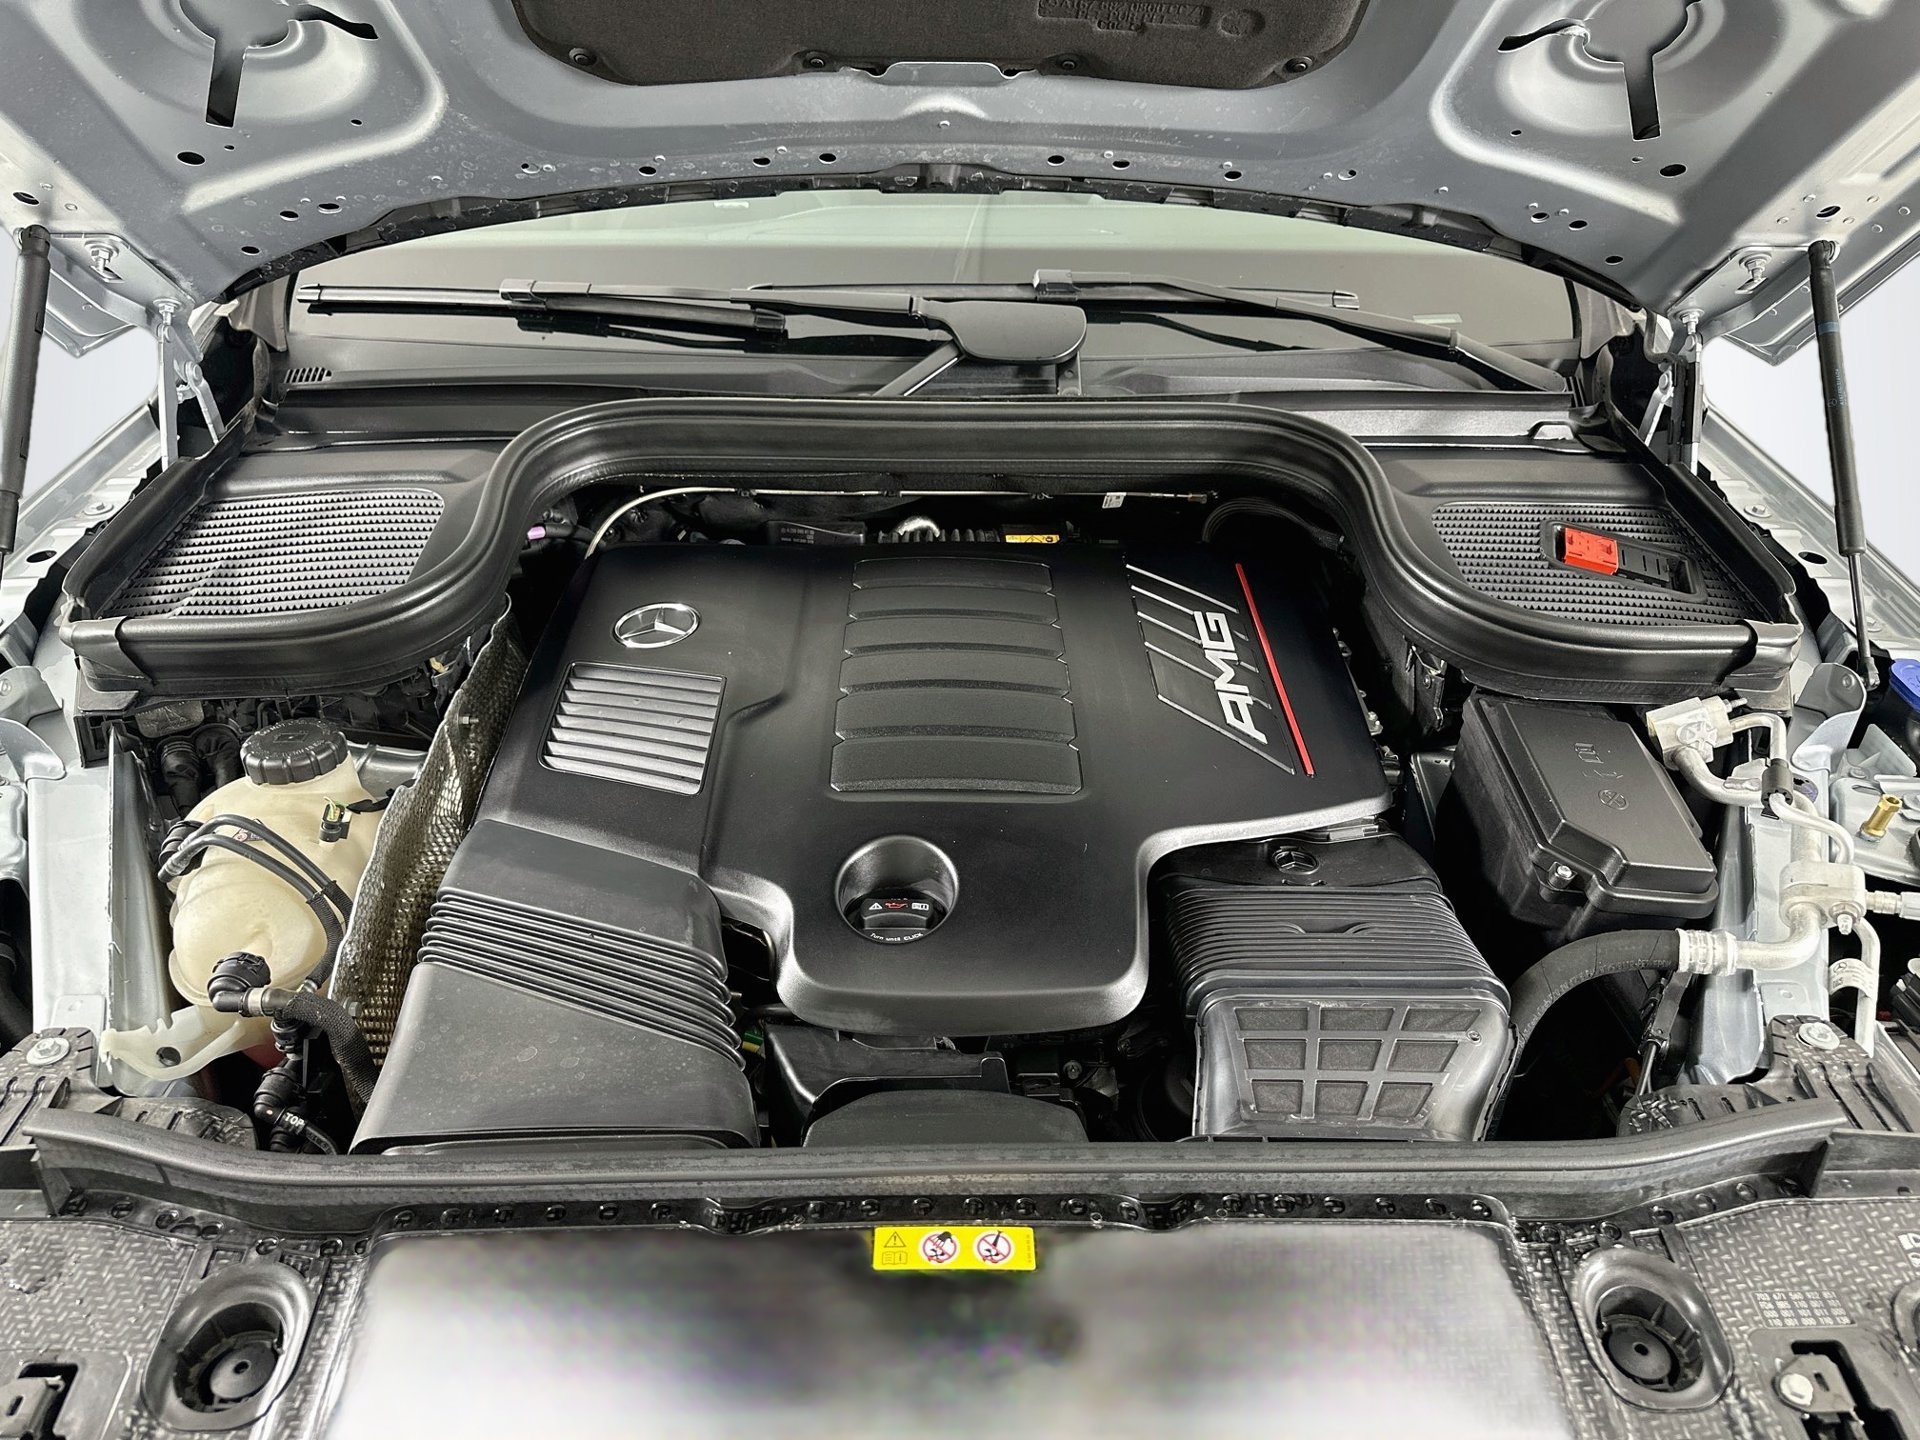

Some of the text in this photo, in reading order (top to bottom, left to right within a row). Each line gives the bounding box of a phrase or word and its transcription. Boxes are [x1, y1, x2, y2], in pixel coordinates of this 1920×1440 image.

[1194, 611, 1268, 744] AMG
[870, 932, 884, 941] Turn
[903, 932, 924, 941] CLICK
[285, 1111, 305, 1127] TOP
